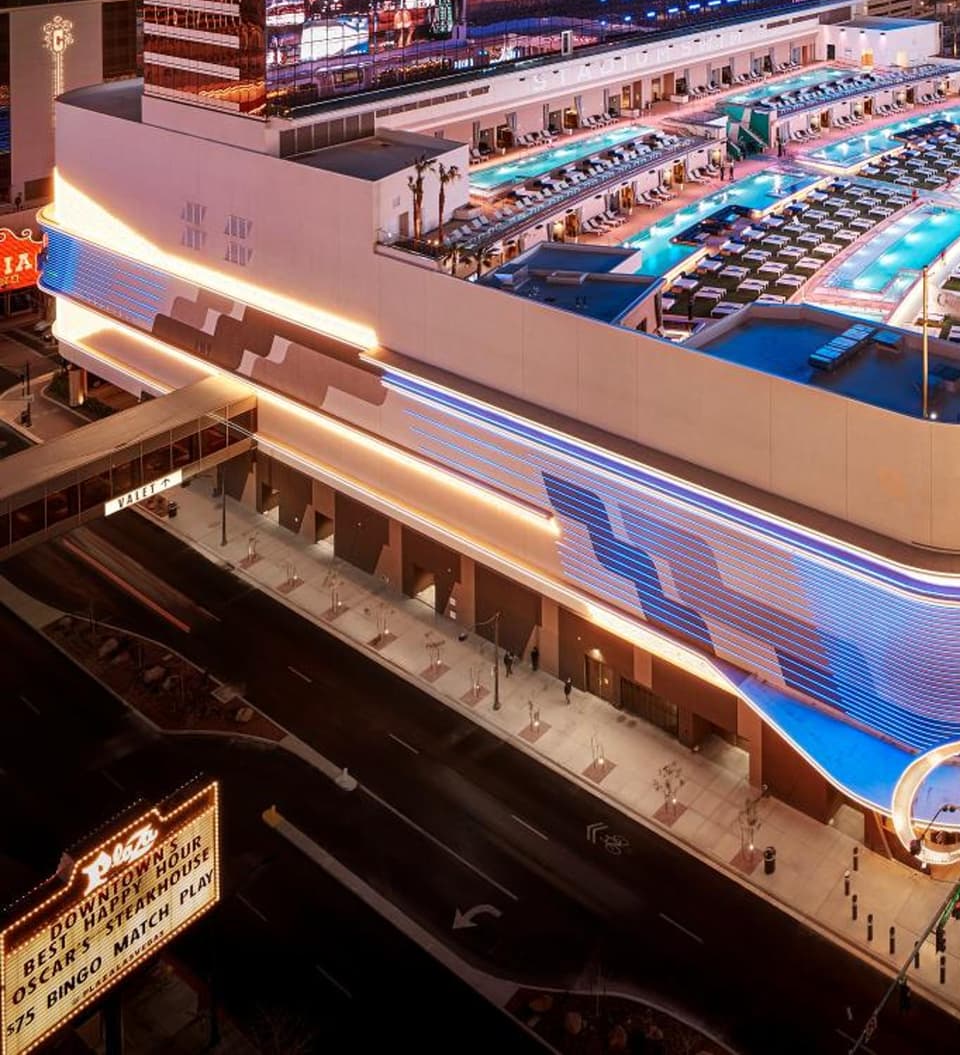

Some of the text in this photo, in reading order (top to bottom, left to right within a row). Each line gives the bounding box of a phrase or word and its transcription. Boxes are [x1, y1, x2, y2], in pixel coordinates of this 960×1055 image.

[118, 484, 154, 507] VALET
[12, 847, 210, 1006] OSCAR'S STEAKHOUSE
[22, 835, 202, 978] BEST HAPPY HOUR
[81, 822, 159, 896] Plaza
[6, 869, 214, 1038] $75 BINGO MATCH PLAY
